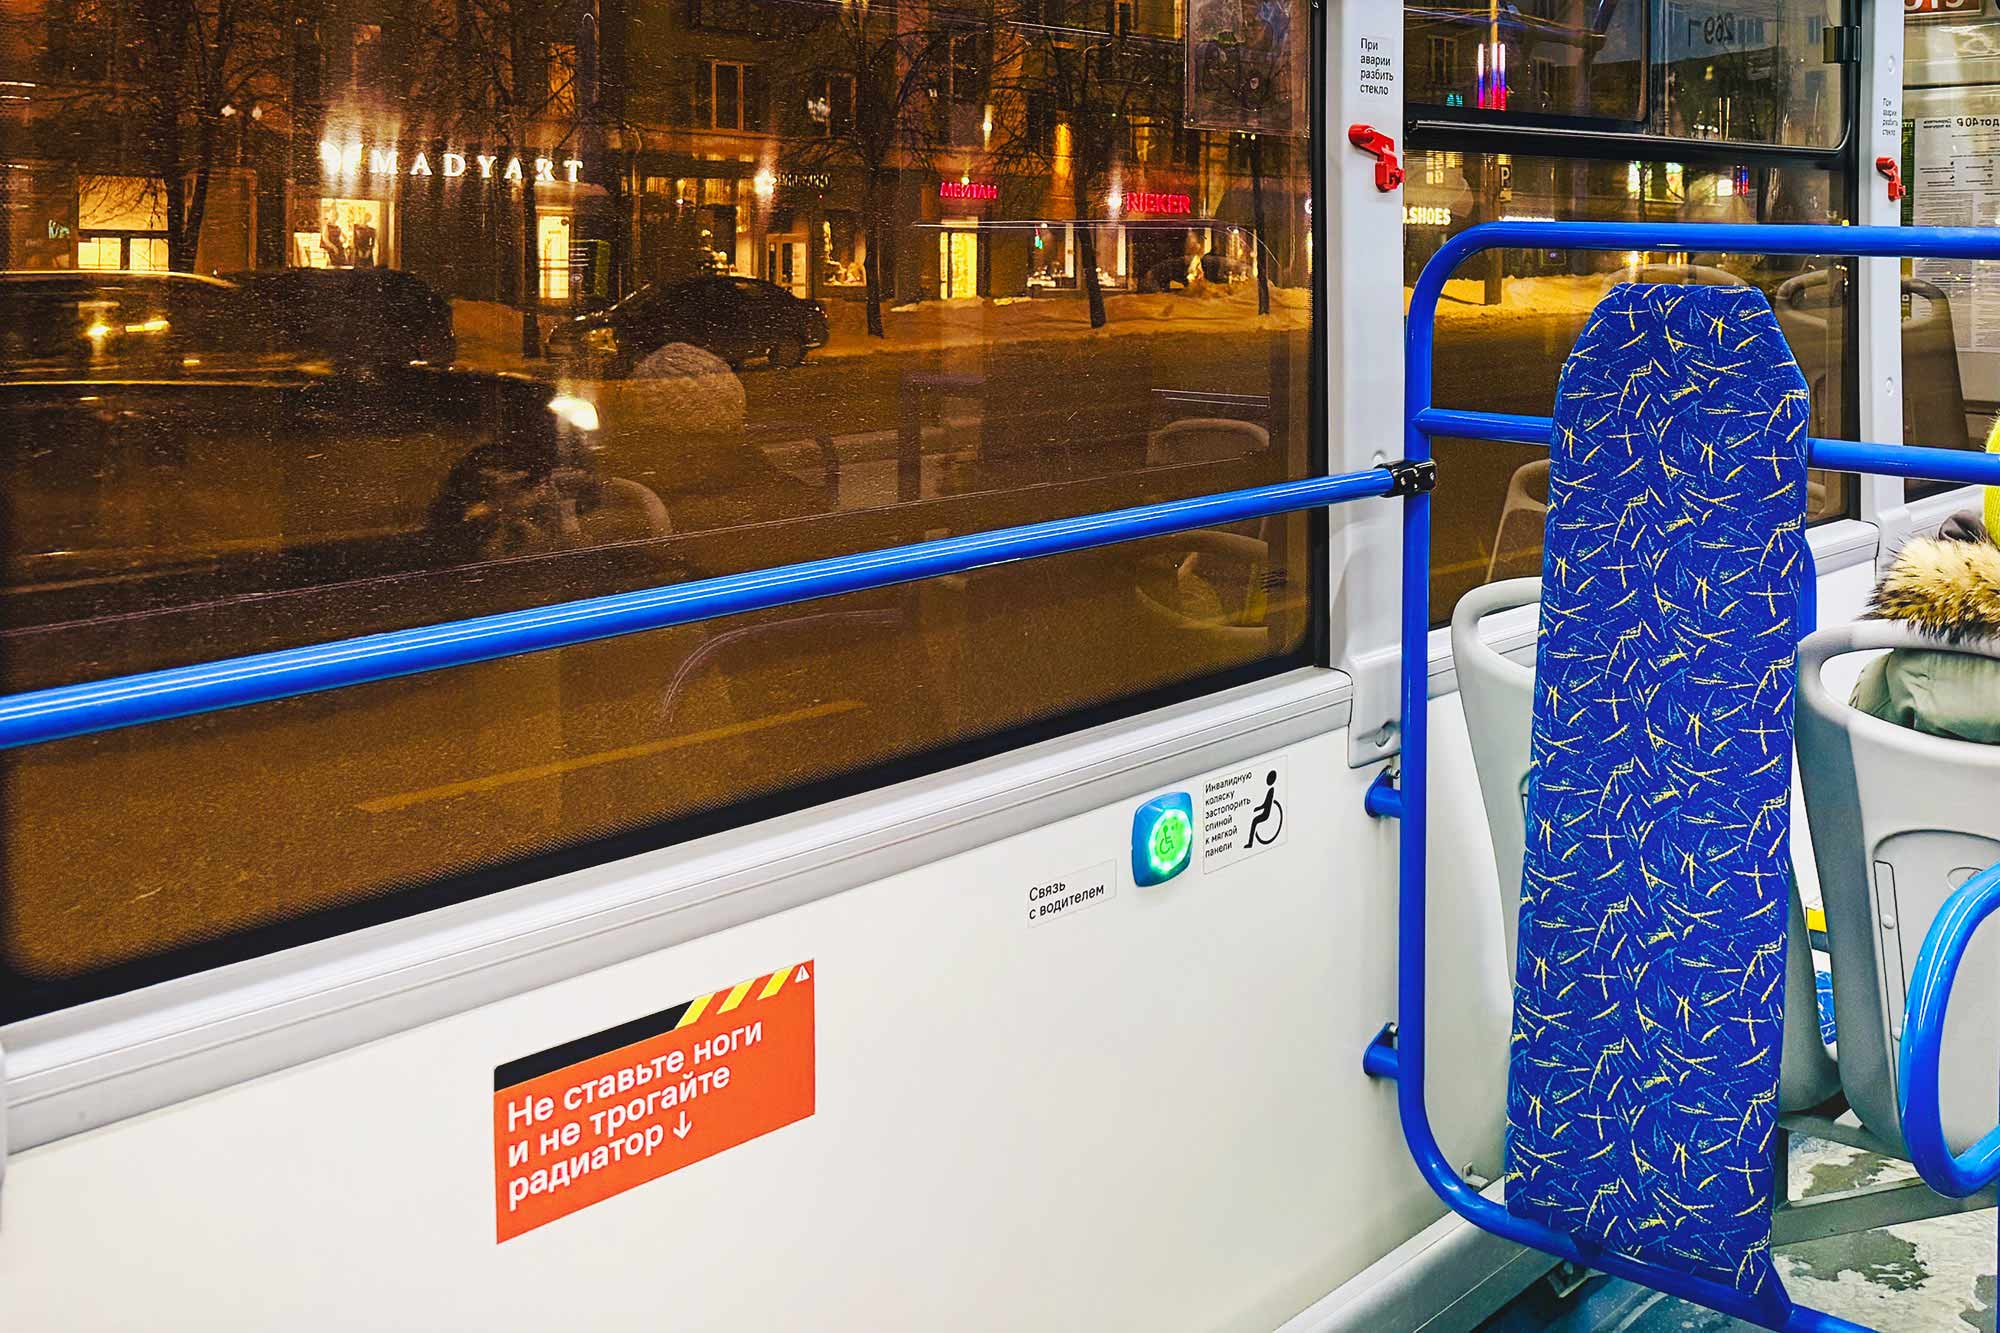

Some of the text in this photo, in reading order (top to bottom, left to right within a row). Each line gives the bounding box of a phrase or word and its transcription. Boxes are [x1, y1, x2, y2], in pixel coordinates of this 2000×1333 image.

[1360, 37, 1378, 52] При
[1360, 55, 1391, 67] аварии
[1360, 69, 1394, 81] разбить
[1360, 84, 1389, 95] стекло
[370, 149, 584, 183] MADYART
[1126, 192, 1191, 214] RIEKER
[1205, 771, 1252, 794] Инвалидную
[1205, 790, 1235, 806] коляску
[1205, 798, 1251, 819] застопорить
[1205, 815, 1233, 832] спиной
[1205, 825, 1238, 845] к мягкой
[1205, 842, 1233, 858] панели
[1029, 882, 1066, 901] Связь
[1029, 885, 1104, 920] с водителем
[508, 1020, 762, 1133] Не ставьте ноги
[508, 1065, 730, 1169] и не трогайте
[508, 1123, 664, 1212] радиатор
